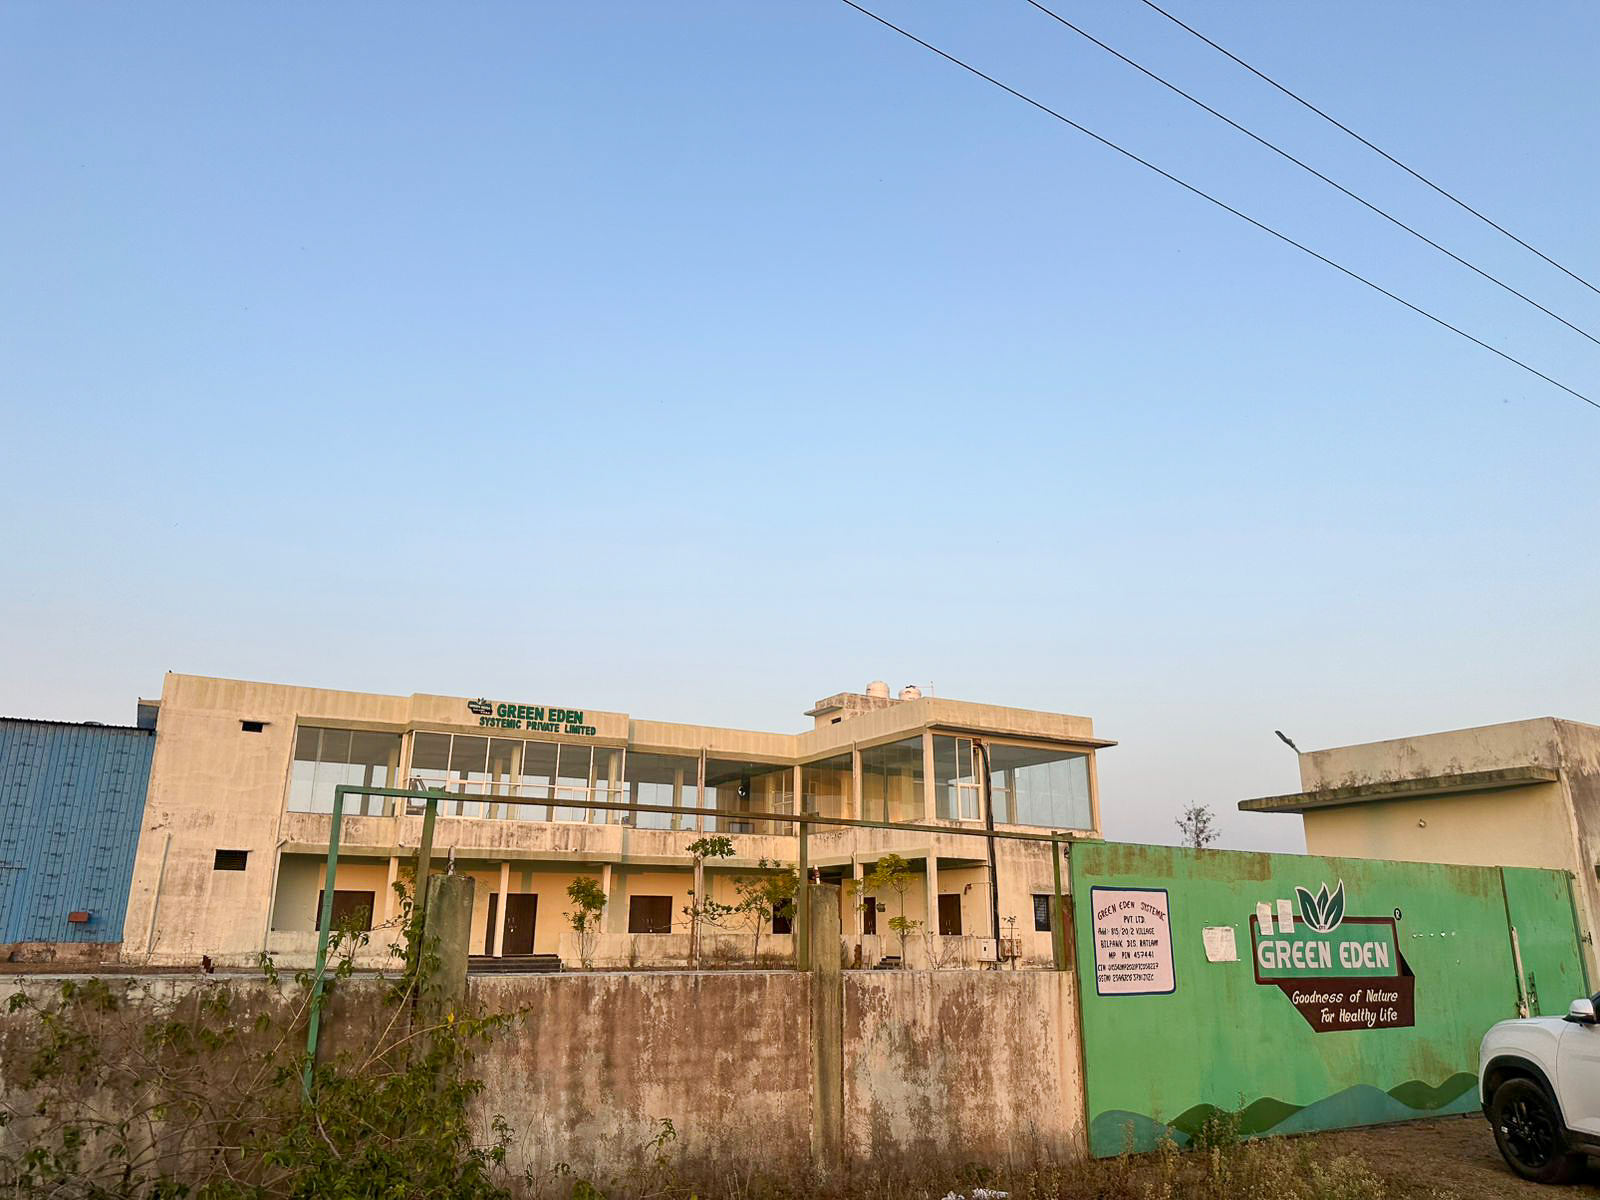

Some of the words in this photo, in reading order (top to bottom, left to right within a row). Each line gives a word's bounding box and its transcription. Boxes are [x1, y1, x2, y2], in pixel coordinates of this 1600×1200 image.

[497, 703, 544, 721] GREEN
[548, 708, 584, 724] EDEN
[479, 716, 522, 729] SYSTEMIC
[526, 721, 560, 733] PRIVATE
[564, 724, 596, 736] LIMITED
[1097, 903, 1117, 920] GREEN
[1119, 900, 1135, 910] EDEN
[1136, 927, 1155, 936] VILLAGE
[1139, 939, 1159, 948] RATLAM
[1122, 951, 1131, 959] PIN
[1257, 940, 1333, 969] GREEN
[1339, 941, 1390, 969] EDEN
[1291, 989, 1344, 1004] Goodness
[1349, 989, 1362, 1003] of
[1366, 988, 1398, 1003] Nature
[1320, 1007, 1335, 1024] For
[1339, 1007, 1377, 1028] Healthy
